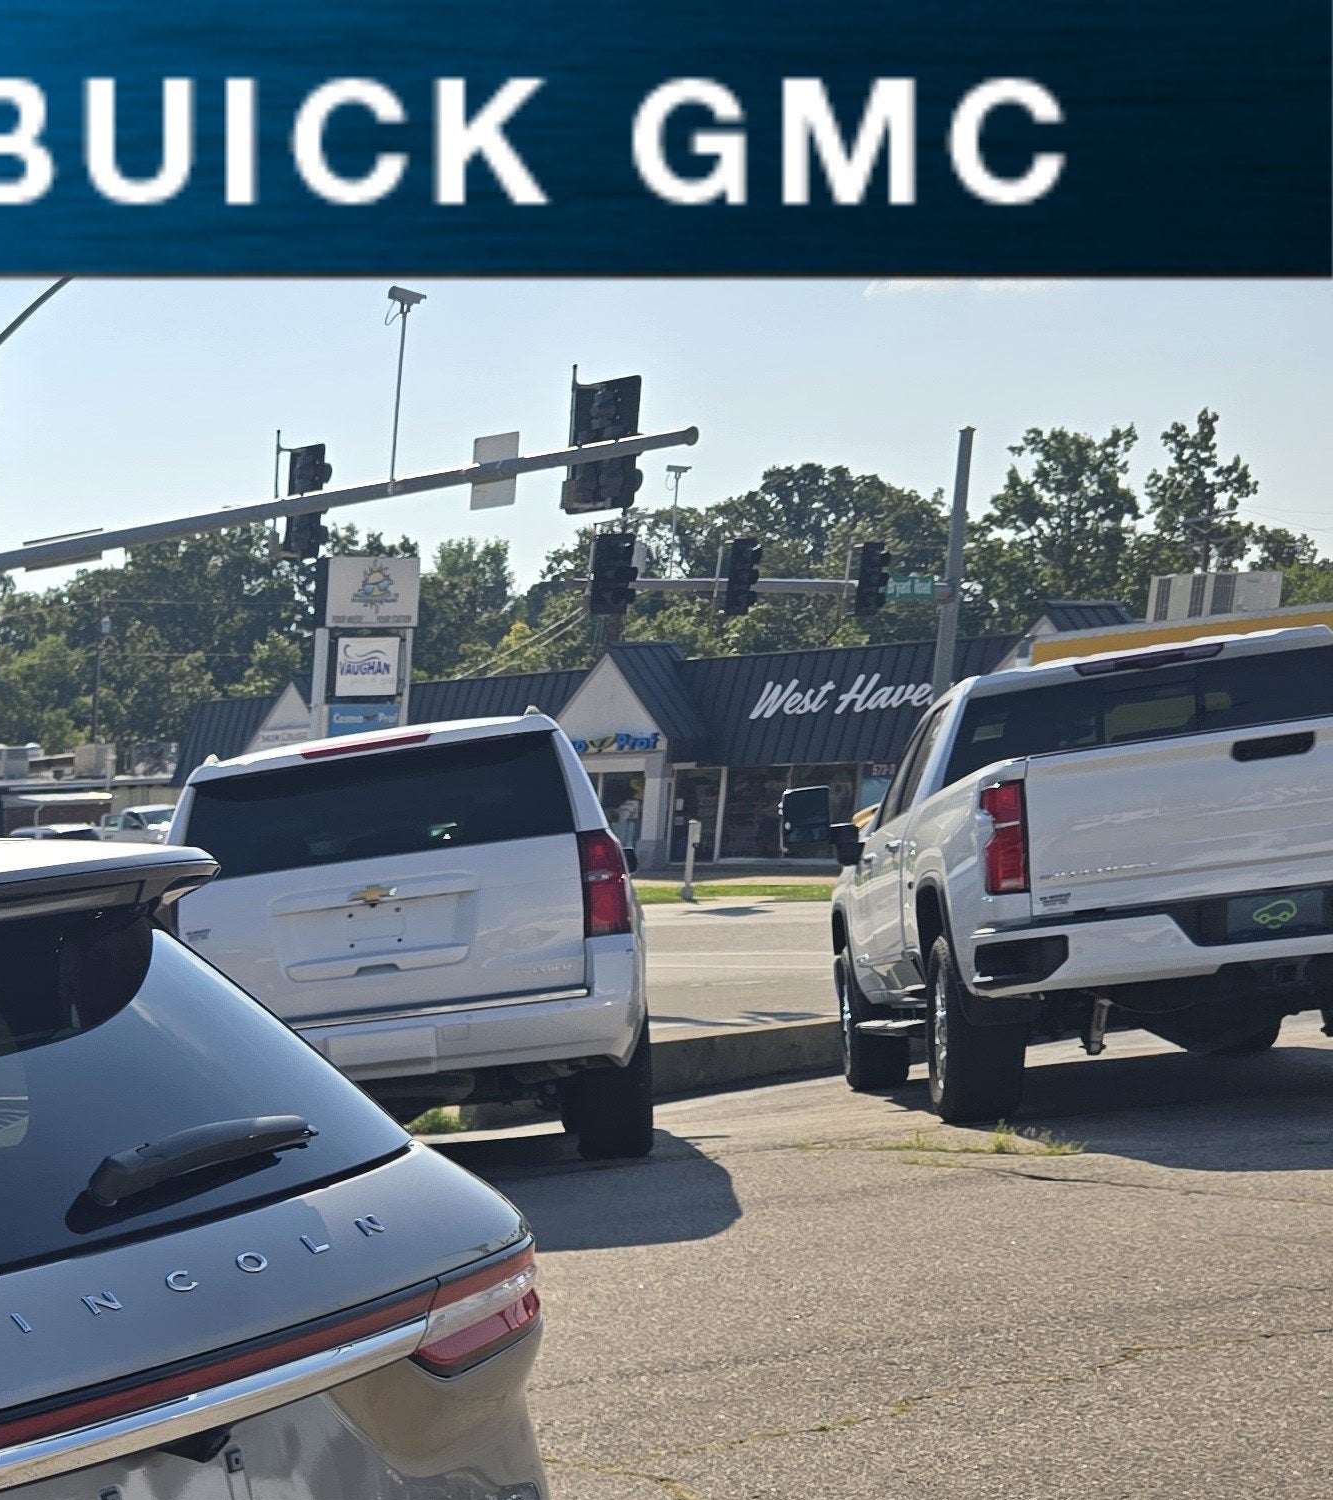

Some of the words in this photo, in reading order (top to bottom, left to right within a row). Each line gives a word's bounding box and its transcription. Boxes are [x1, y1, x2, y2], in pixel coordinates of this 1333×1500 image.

[339, 660, 392, 676] VAUGHAN
[748, 678, 836, 720] West
[834, 672, 936, 715] Have
[616, 732, 660, 751] Prof
